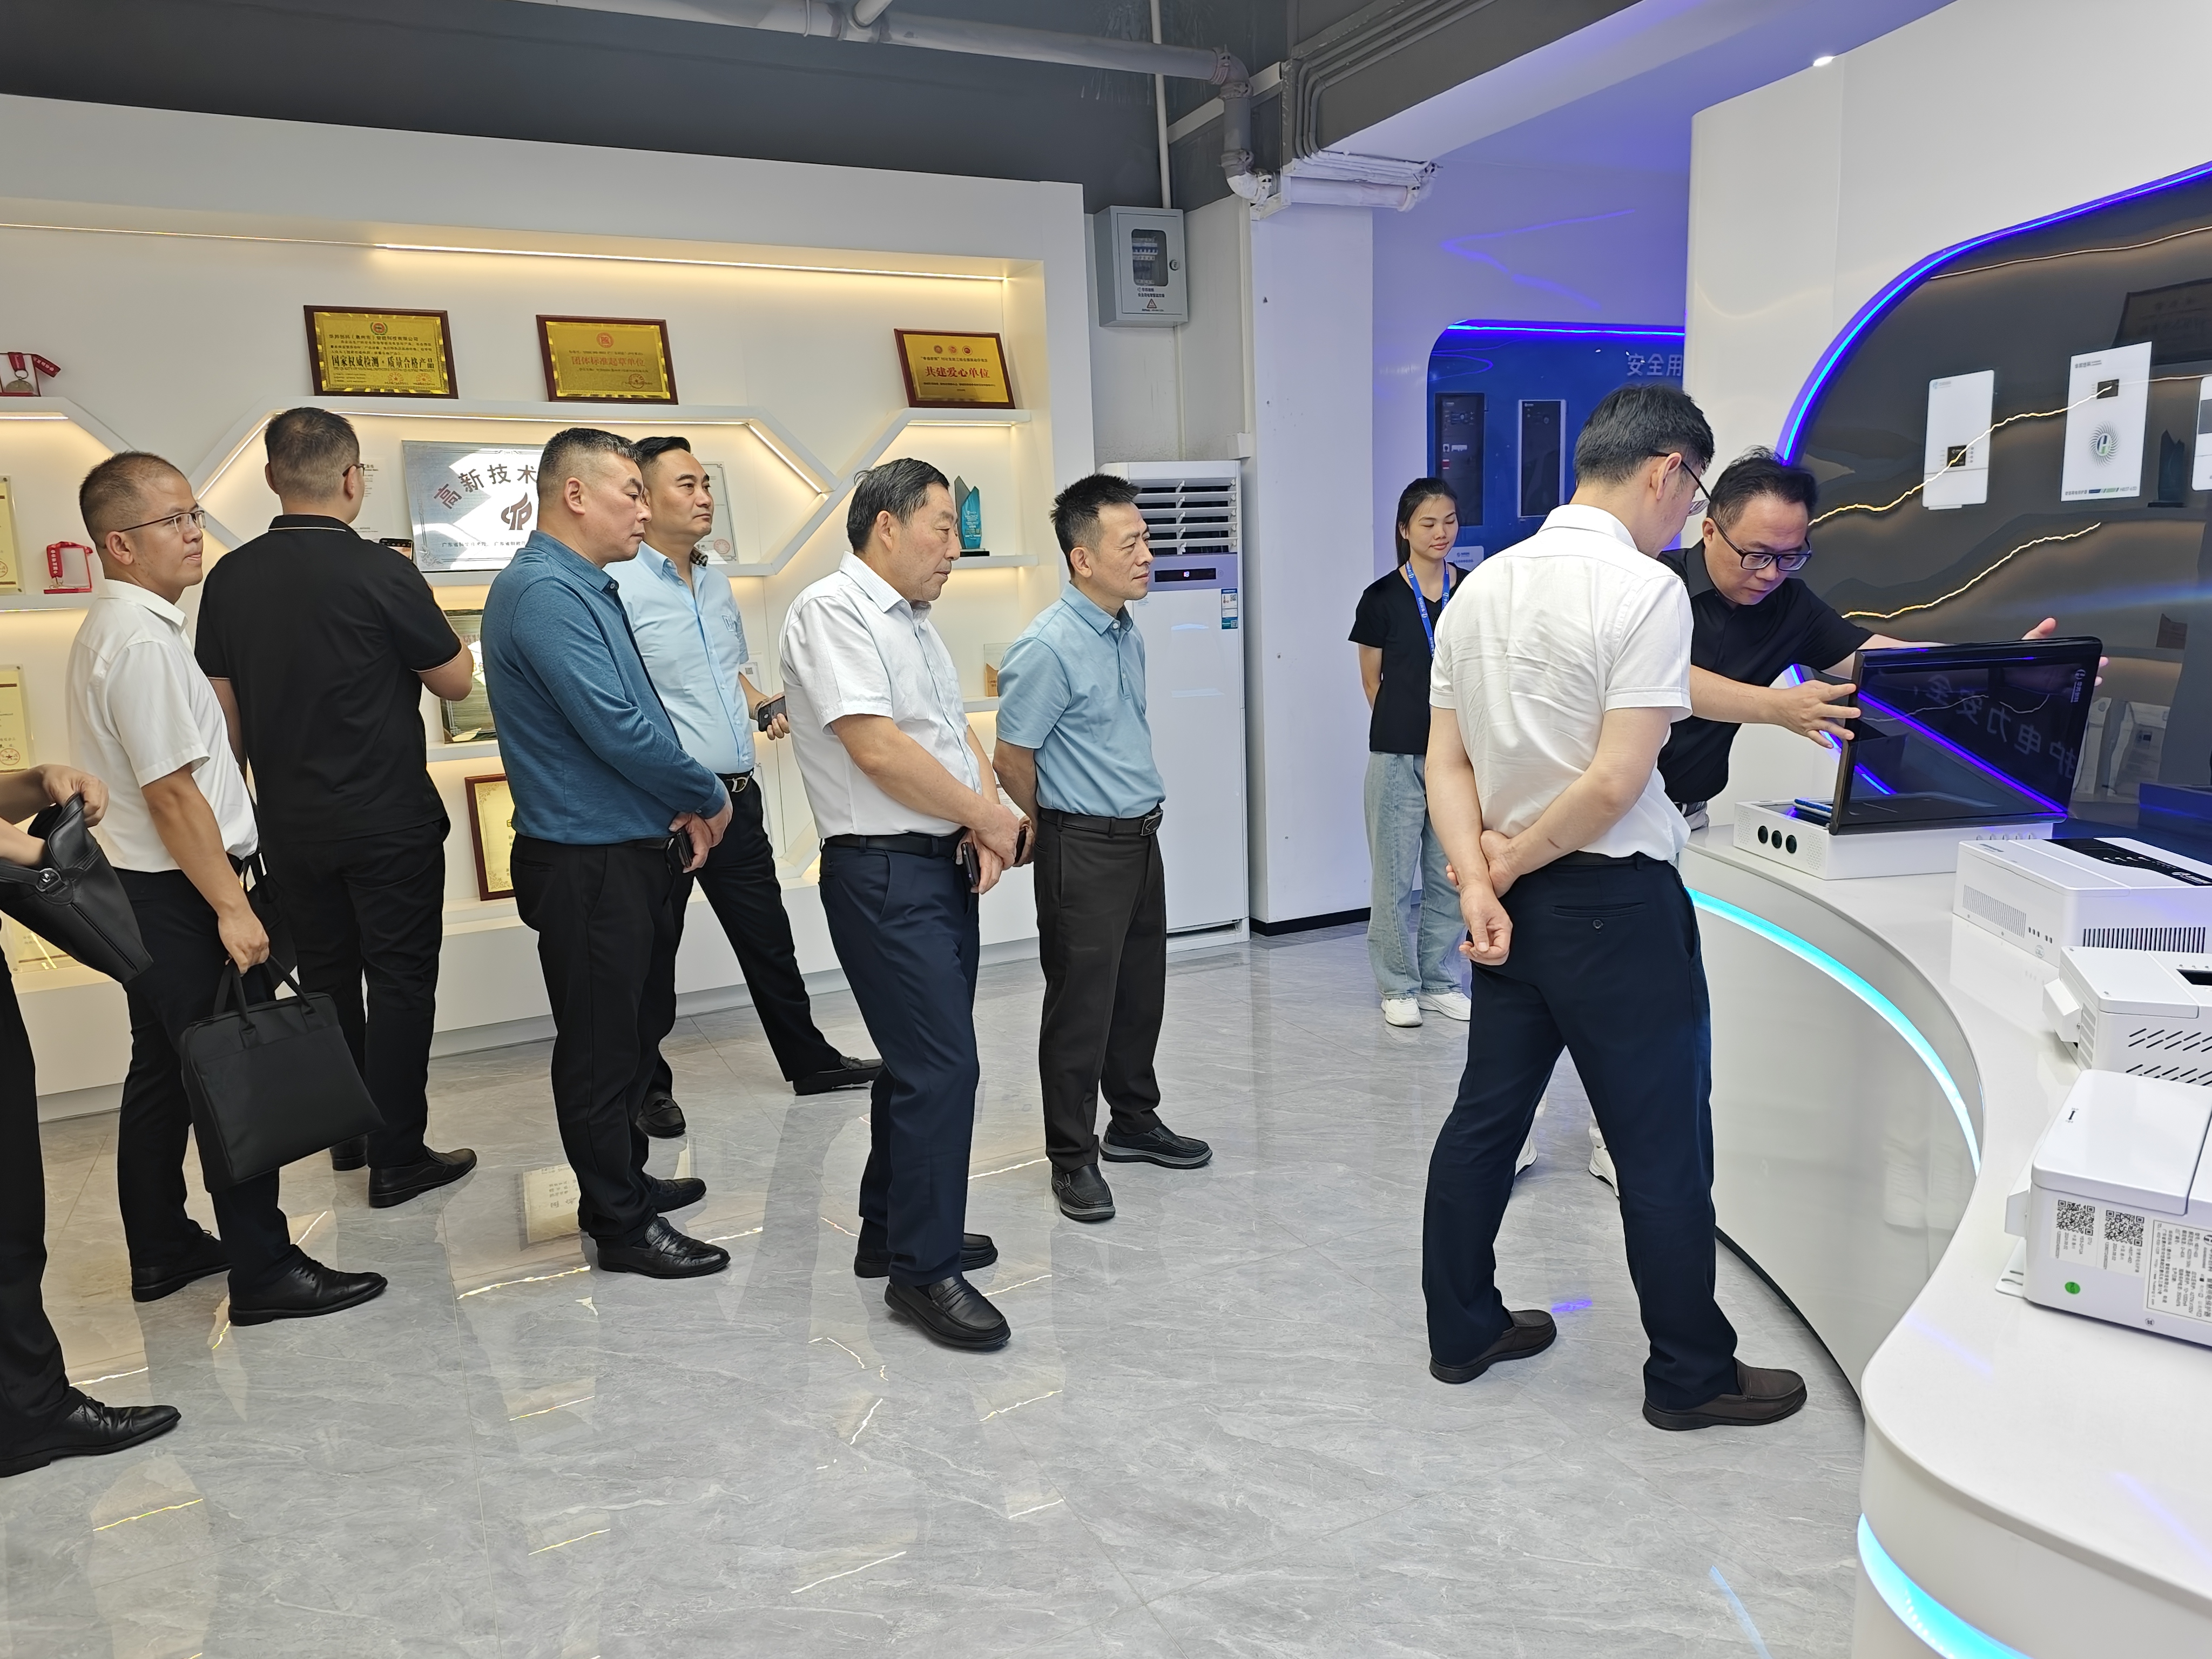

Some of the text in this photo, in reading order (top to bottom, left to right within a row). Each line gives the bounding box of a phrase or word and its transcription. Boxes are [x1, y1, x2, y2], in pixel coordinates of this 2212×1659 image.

[571, 356, 645, 367] 团体标准起草单位
[1627, 353, 1683, 376] 安全用
[925, 366, 990, 378] 共建爱心单位
